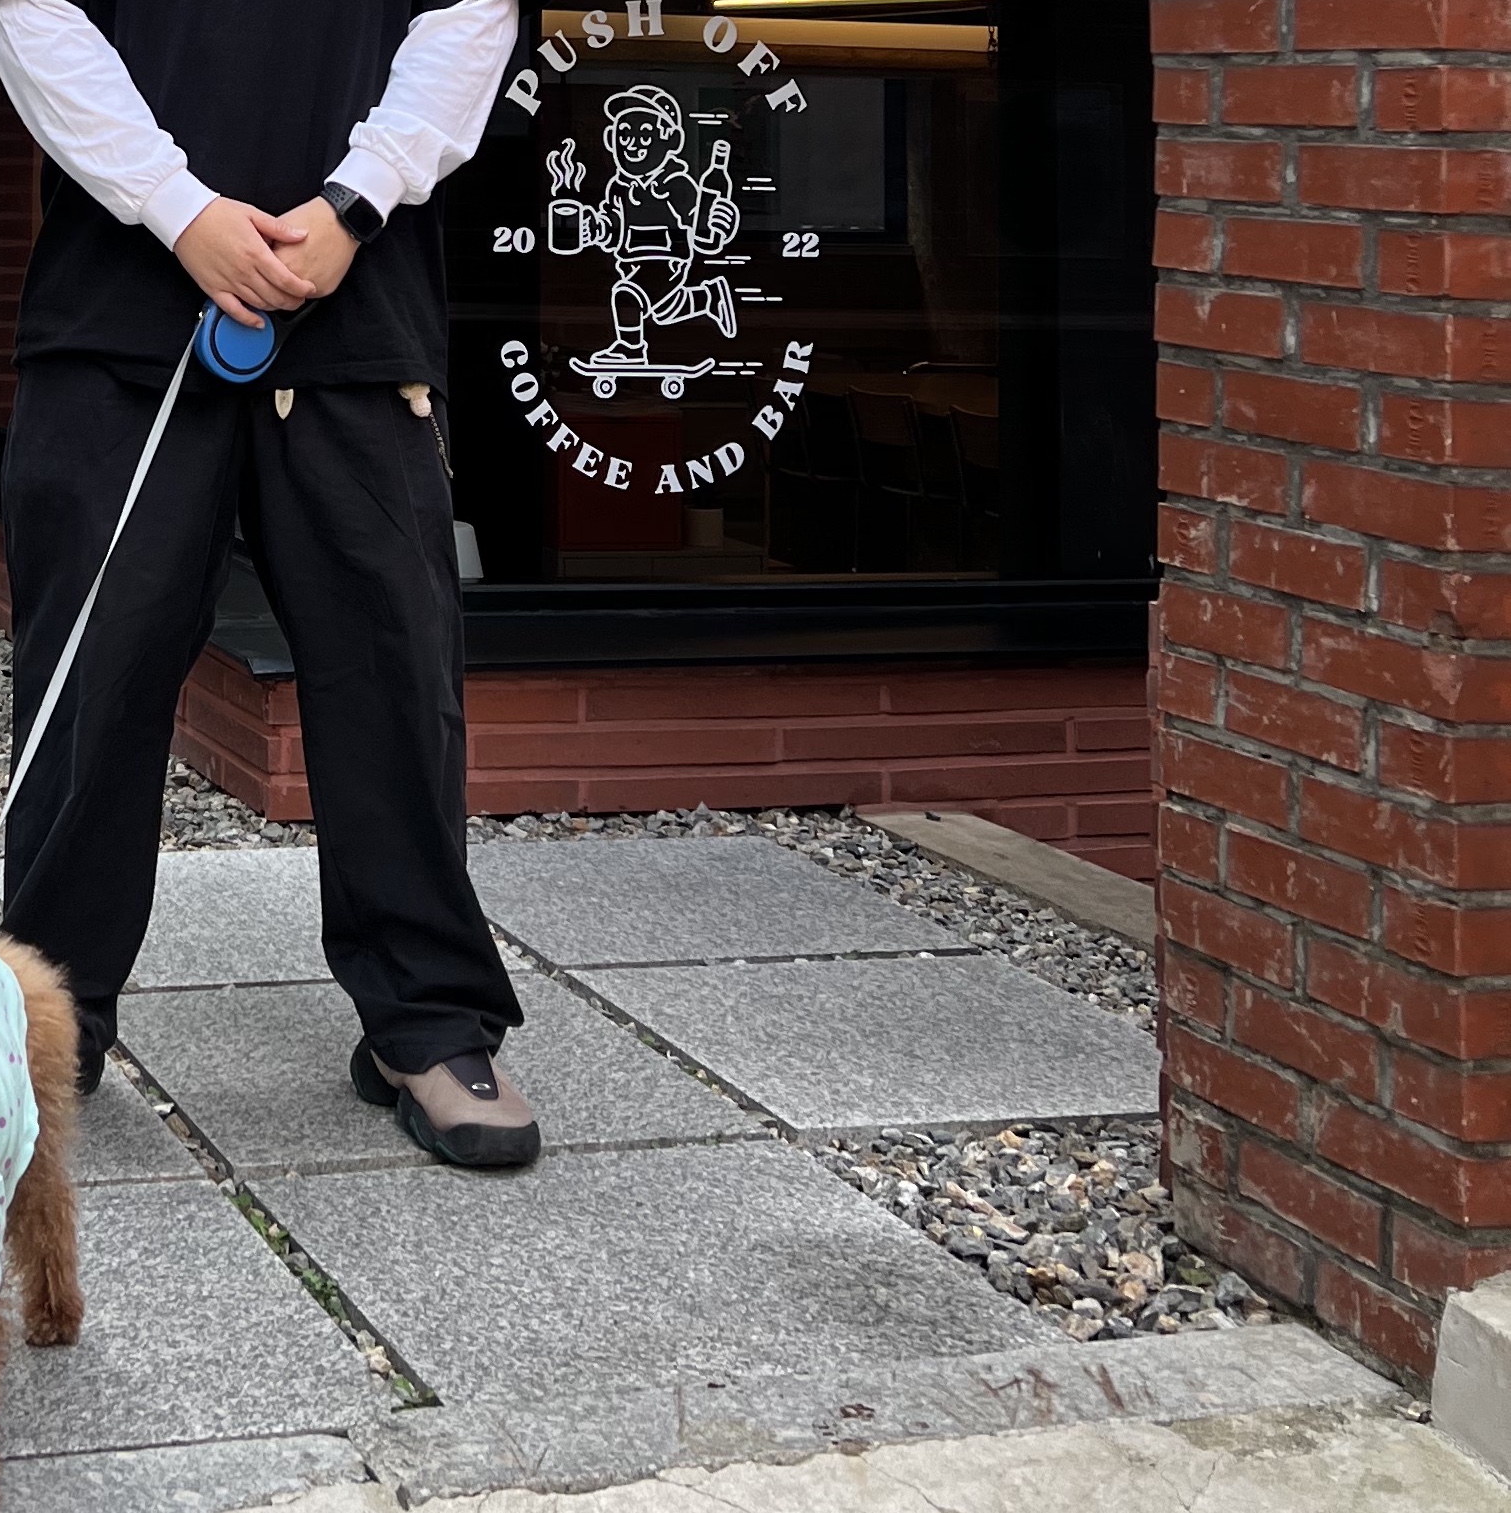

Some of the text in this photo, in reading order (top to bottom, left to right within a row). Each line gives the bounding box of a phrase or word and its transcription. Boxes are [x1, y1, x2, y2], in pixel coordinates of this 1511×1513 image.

[703, 15, 809, 116] OFF
[492, 226, 536, 254] 20
[782, 232, 820, 258] 22
[500, 340, 815, 495] COFFEE AND BAR
